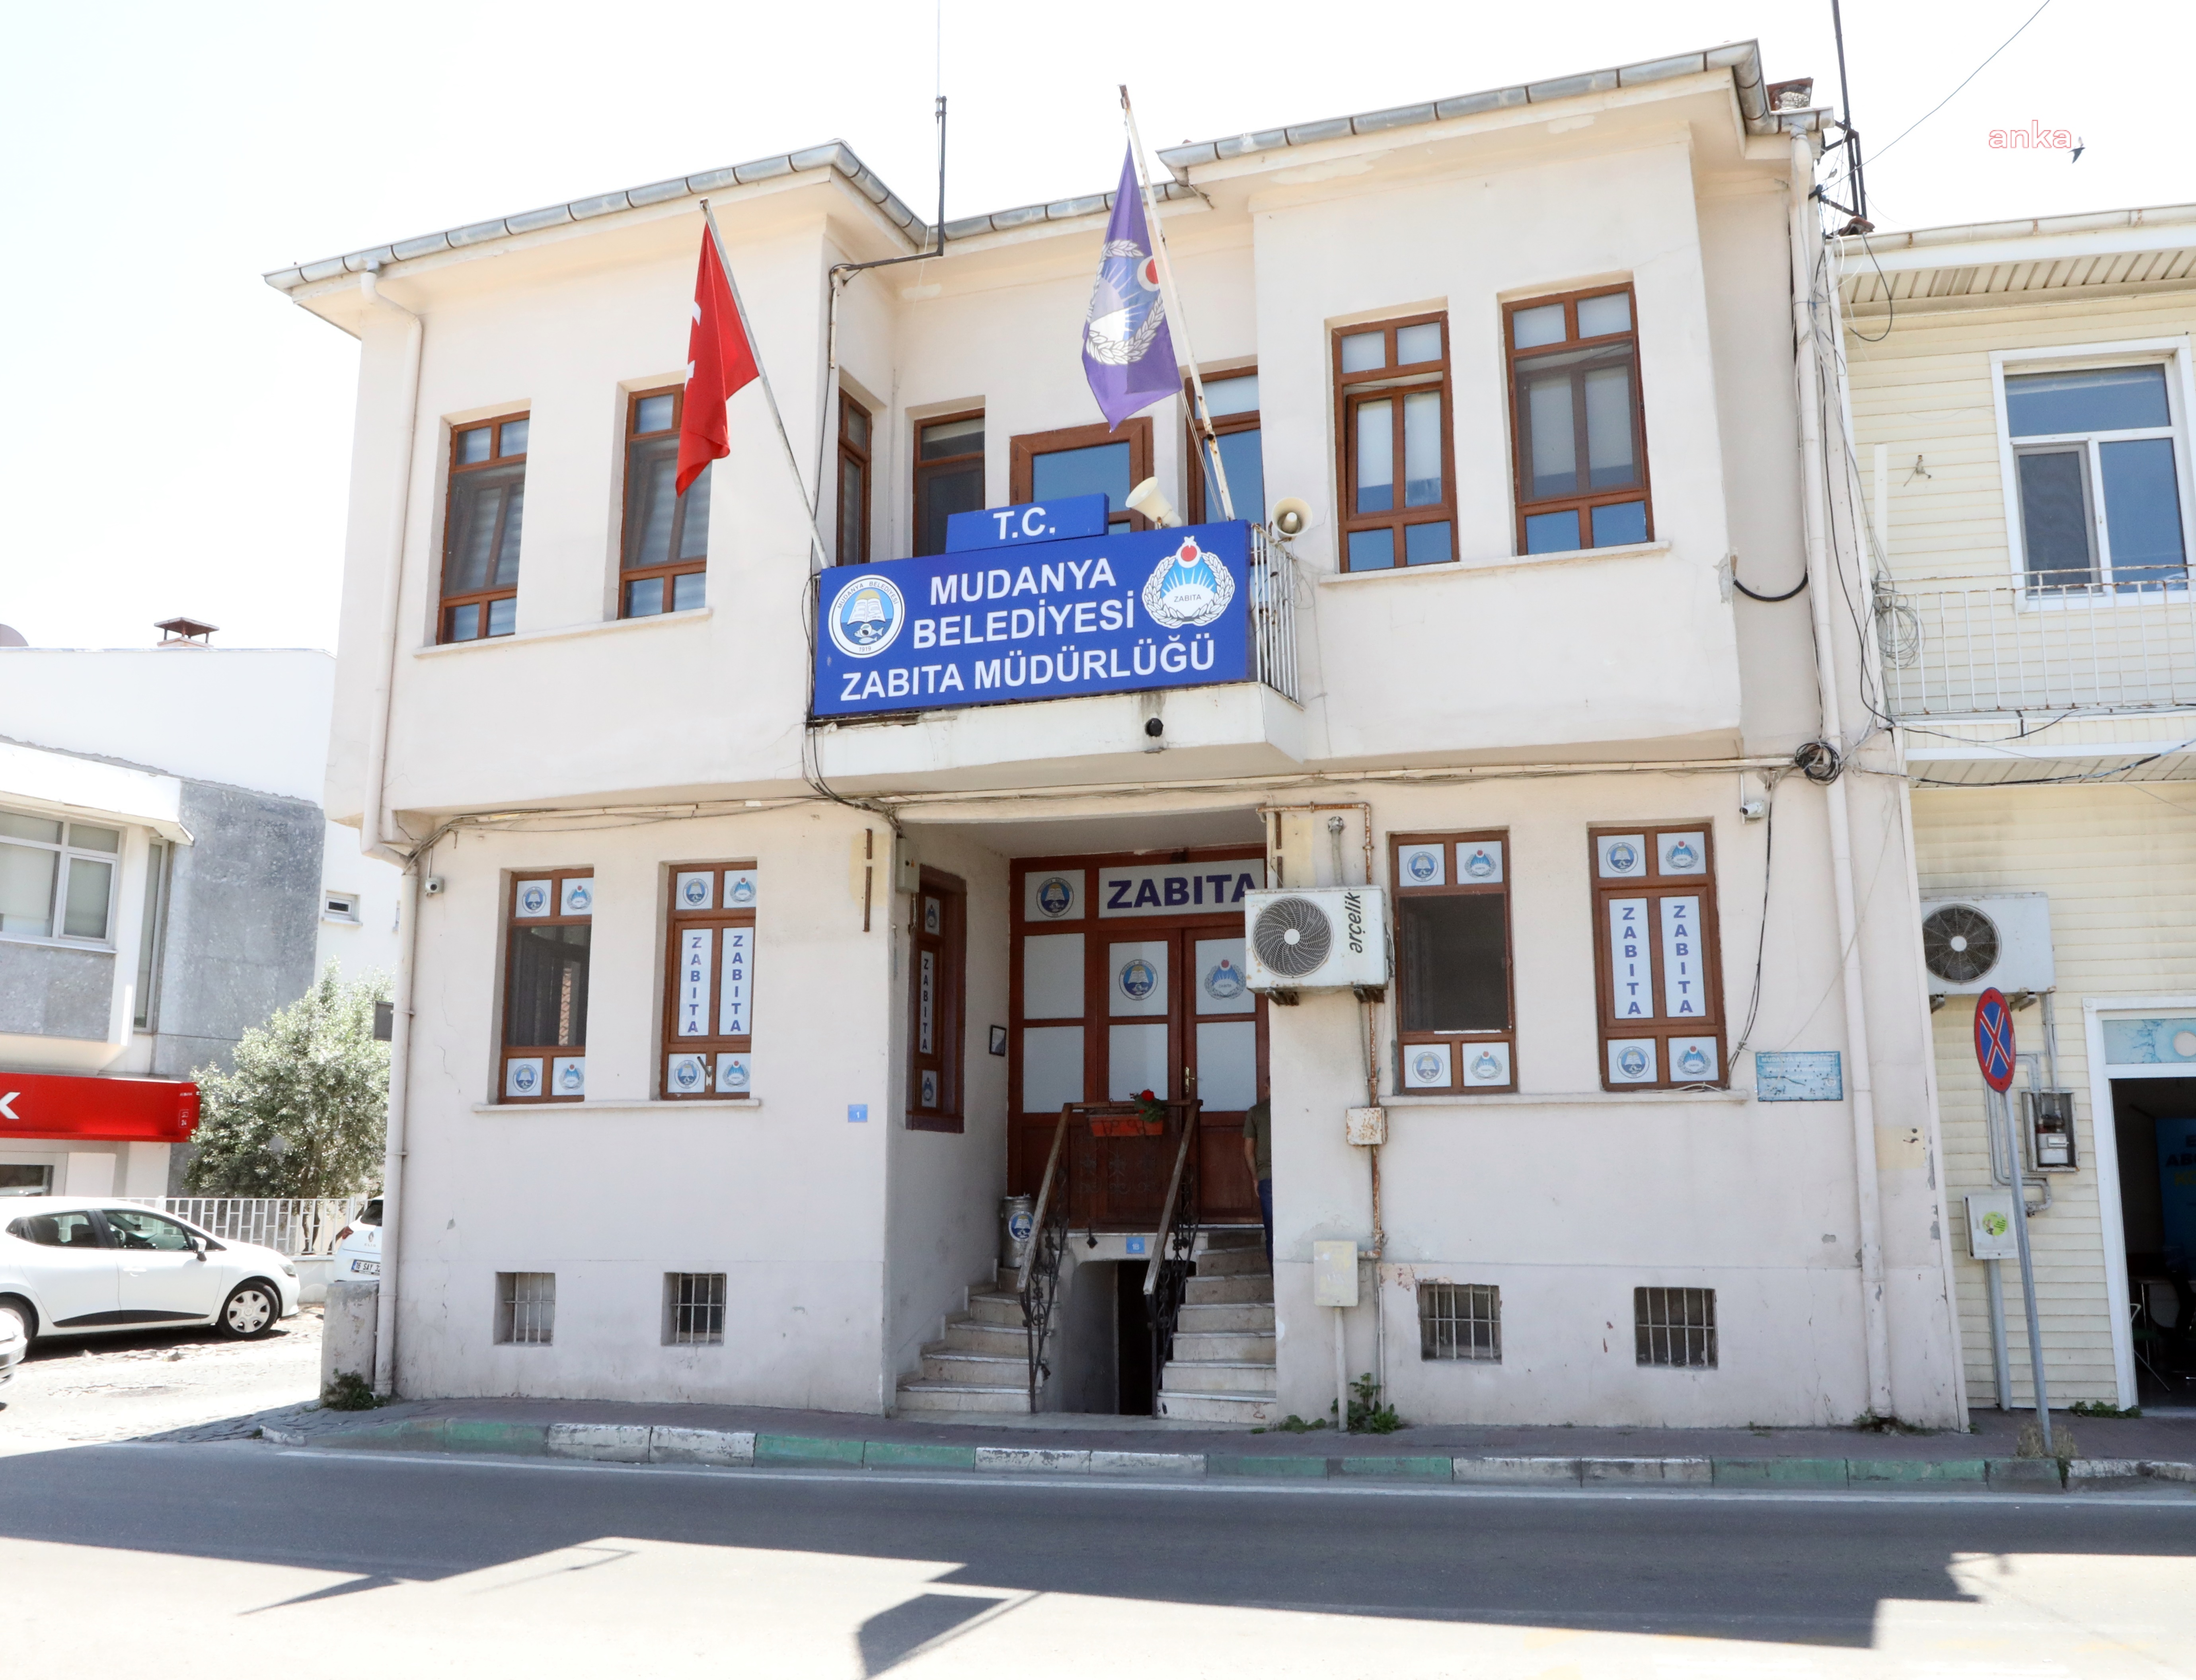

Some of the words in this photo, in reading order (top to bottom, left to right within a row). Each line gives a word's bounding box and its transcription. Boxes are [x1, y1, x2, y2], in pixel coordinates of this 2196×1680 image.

[993, 507, 1055, 540] T.C.
[837, 583, 864, 609] MUDANYA
[869, 581, 899, 605] BELEDİYESİ
[931, 558, 1117, 605] MUDANYA
[1174, 594, 1202, 603] ZABITA
[914, 590, 1134, 649] BELEDİYESİ
[840, 664, 964, 701] ZABITA
[975, 633, 1214, 689] MÜDÜRLÜĞÜ
[1107, 873, 1256, 909] ZABITA
[1344, 892, 1366, 954] arçelik
[688, 937, 702, 1032] ZABITA
[730, 935, 743, 1032] ZABITA
[1623, 907, 1641, 1014] ZABITA
[1674, 905, 1693, 1013] ZABITA
[2166, 1153, 2196, 1167] AB
